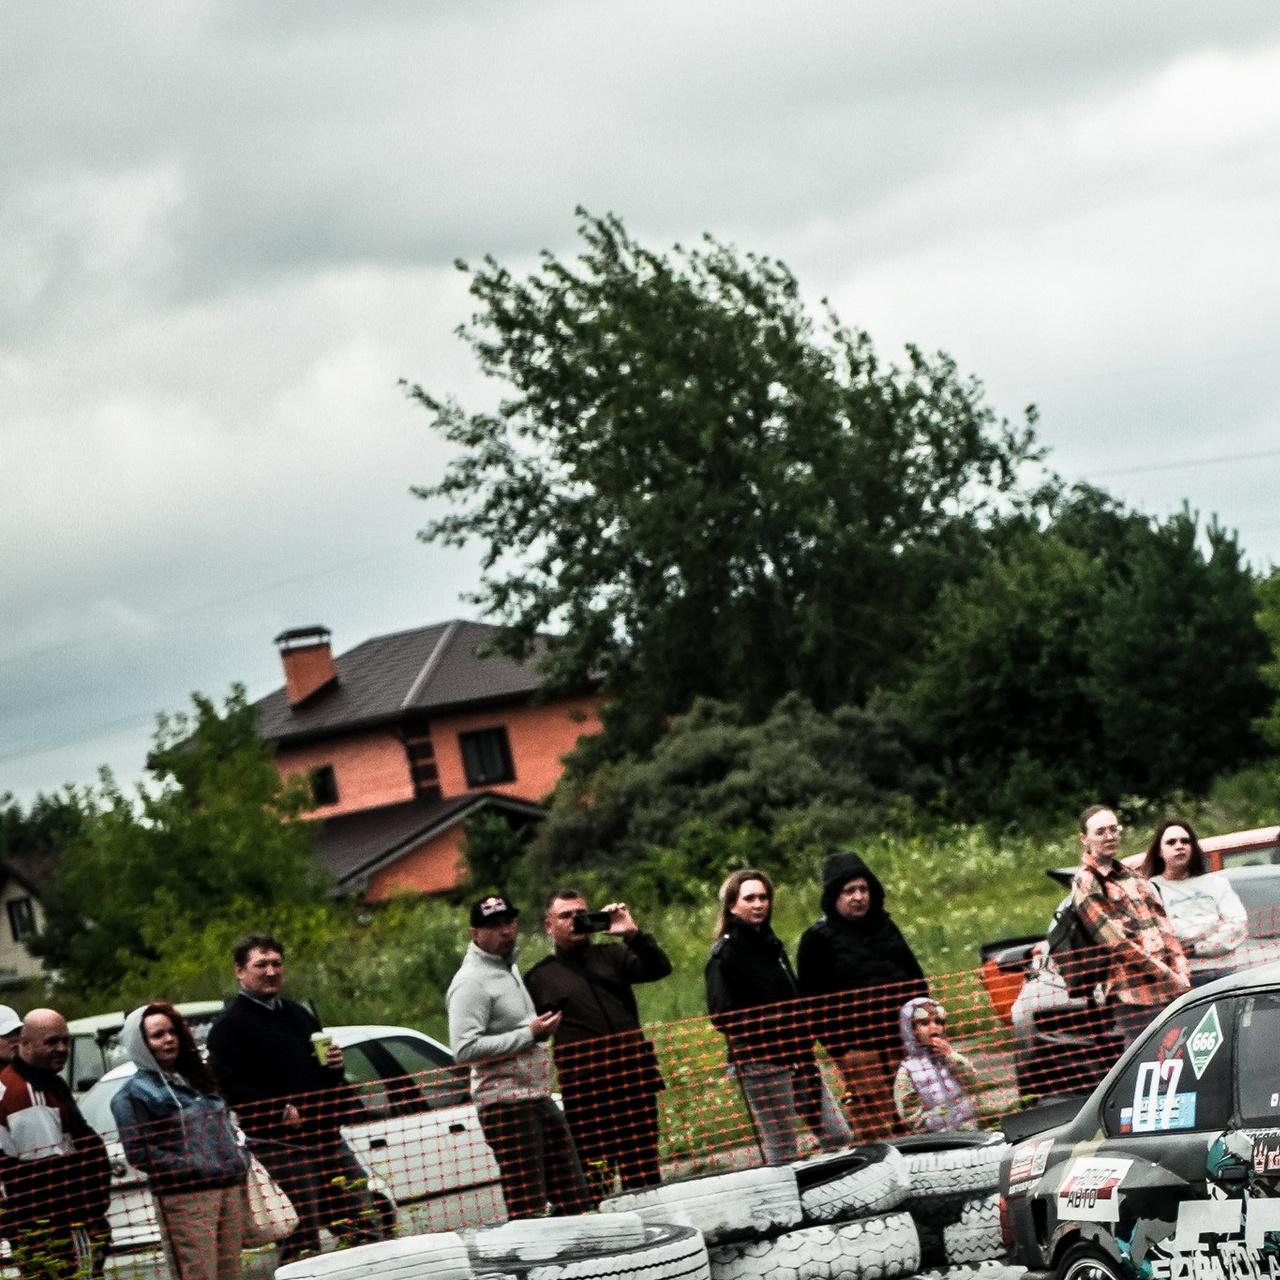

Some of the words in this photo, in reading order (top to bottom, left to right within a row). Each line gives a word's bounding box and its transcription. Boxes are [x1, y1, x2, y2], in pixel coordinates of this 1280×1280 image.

[1192, 1031, 1217, 1052] 666
[1131, 1058, 1184, 1133] 07
[1066, 1187, 1099, 1209] АВТО
